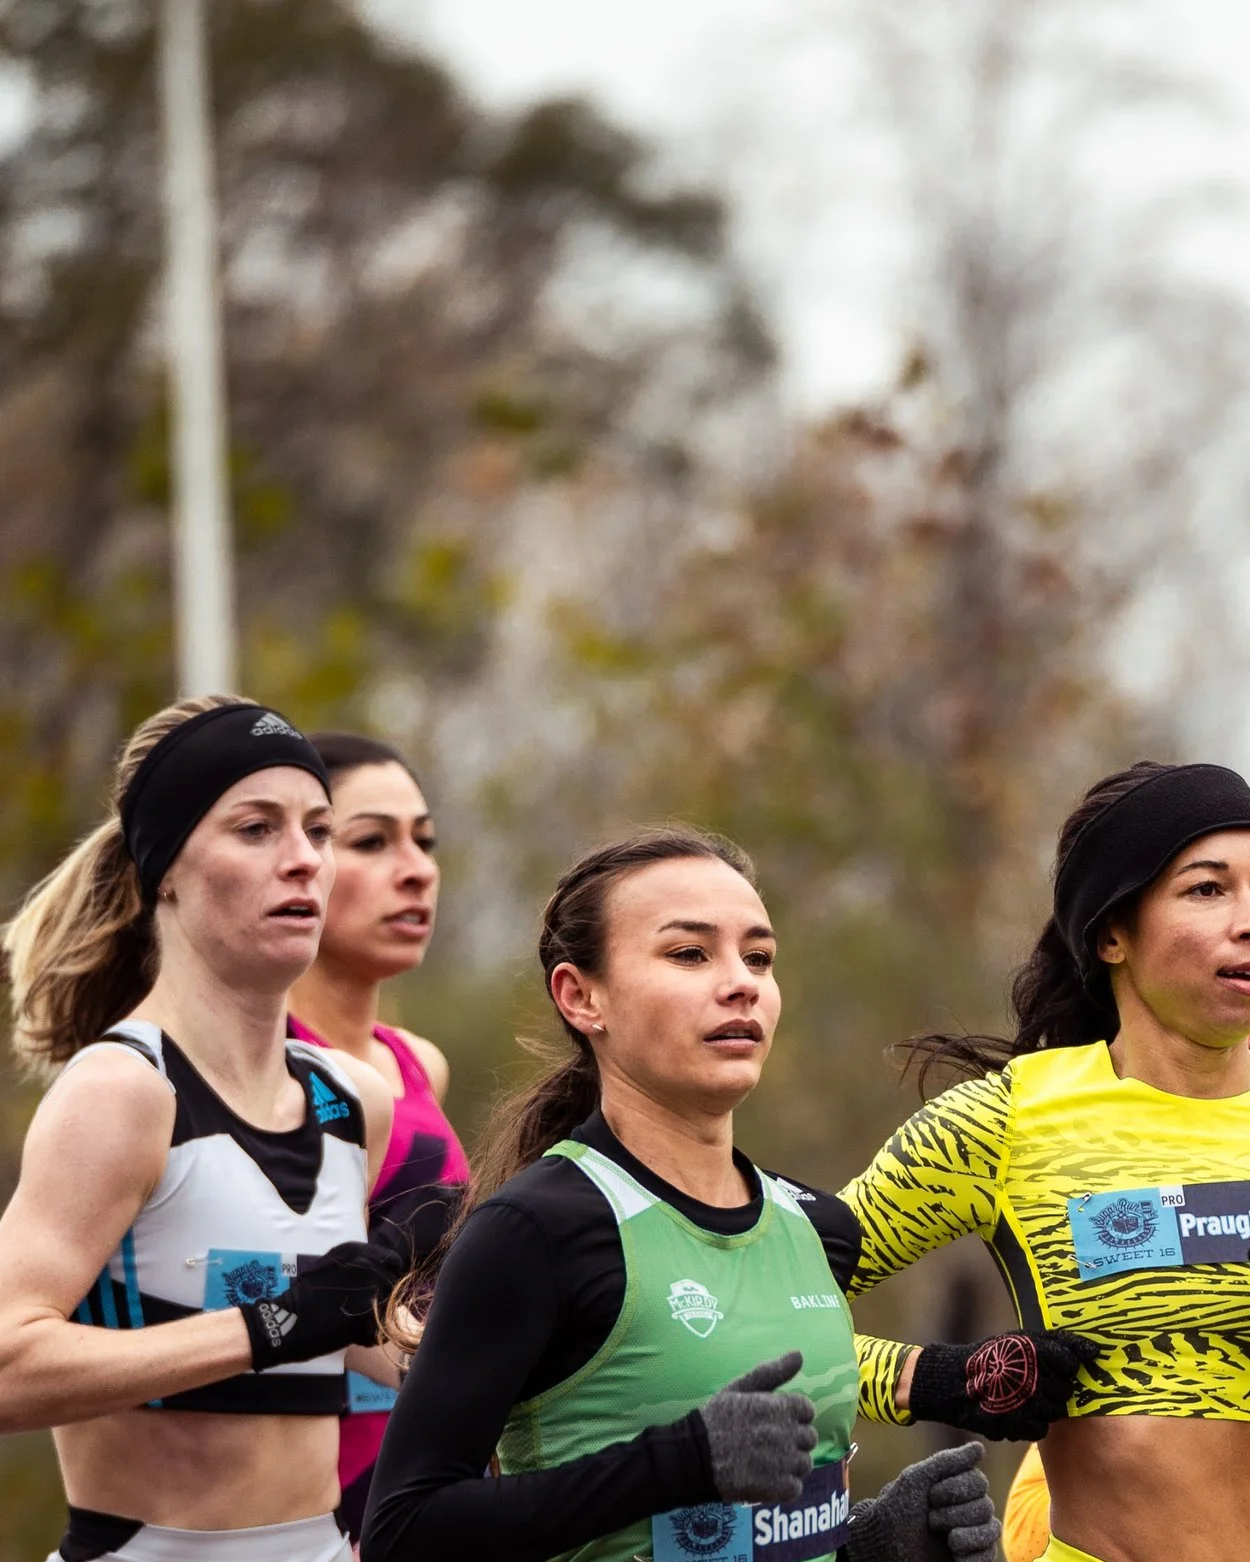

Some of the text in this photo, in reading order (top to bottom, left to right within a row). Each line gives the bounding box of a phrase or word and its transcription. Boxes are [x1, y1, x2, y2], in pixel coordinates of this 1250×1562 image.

[250, 726, 303, 740] adidas
[1161, 1194, 1184, 1206] PRO
[1093, 1247, 1176, 1268] SWEET 16
[258, 1302, 282, 1348] adidas
[754, 1489, 850, 1546] Shanaha
